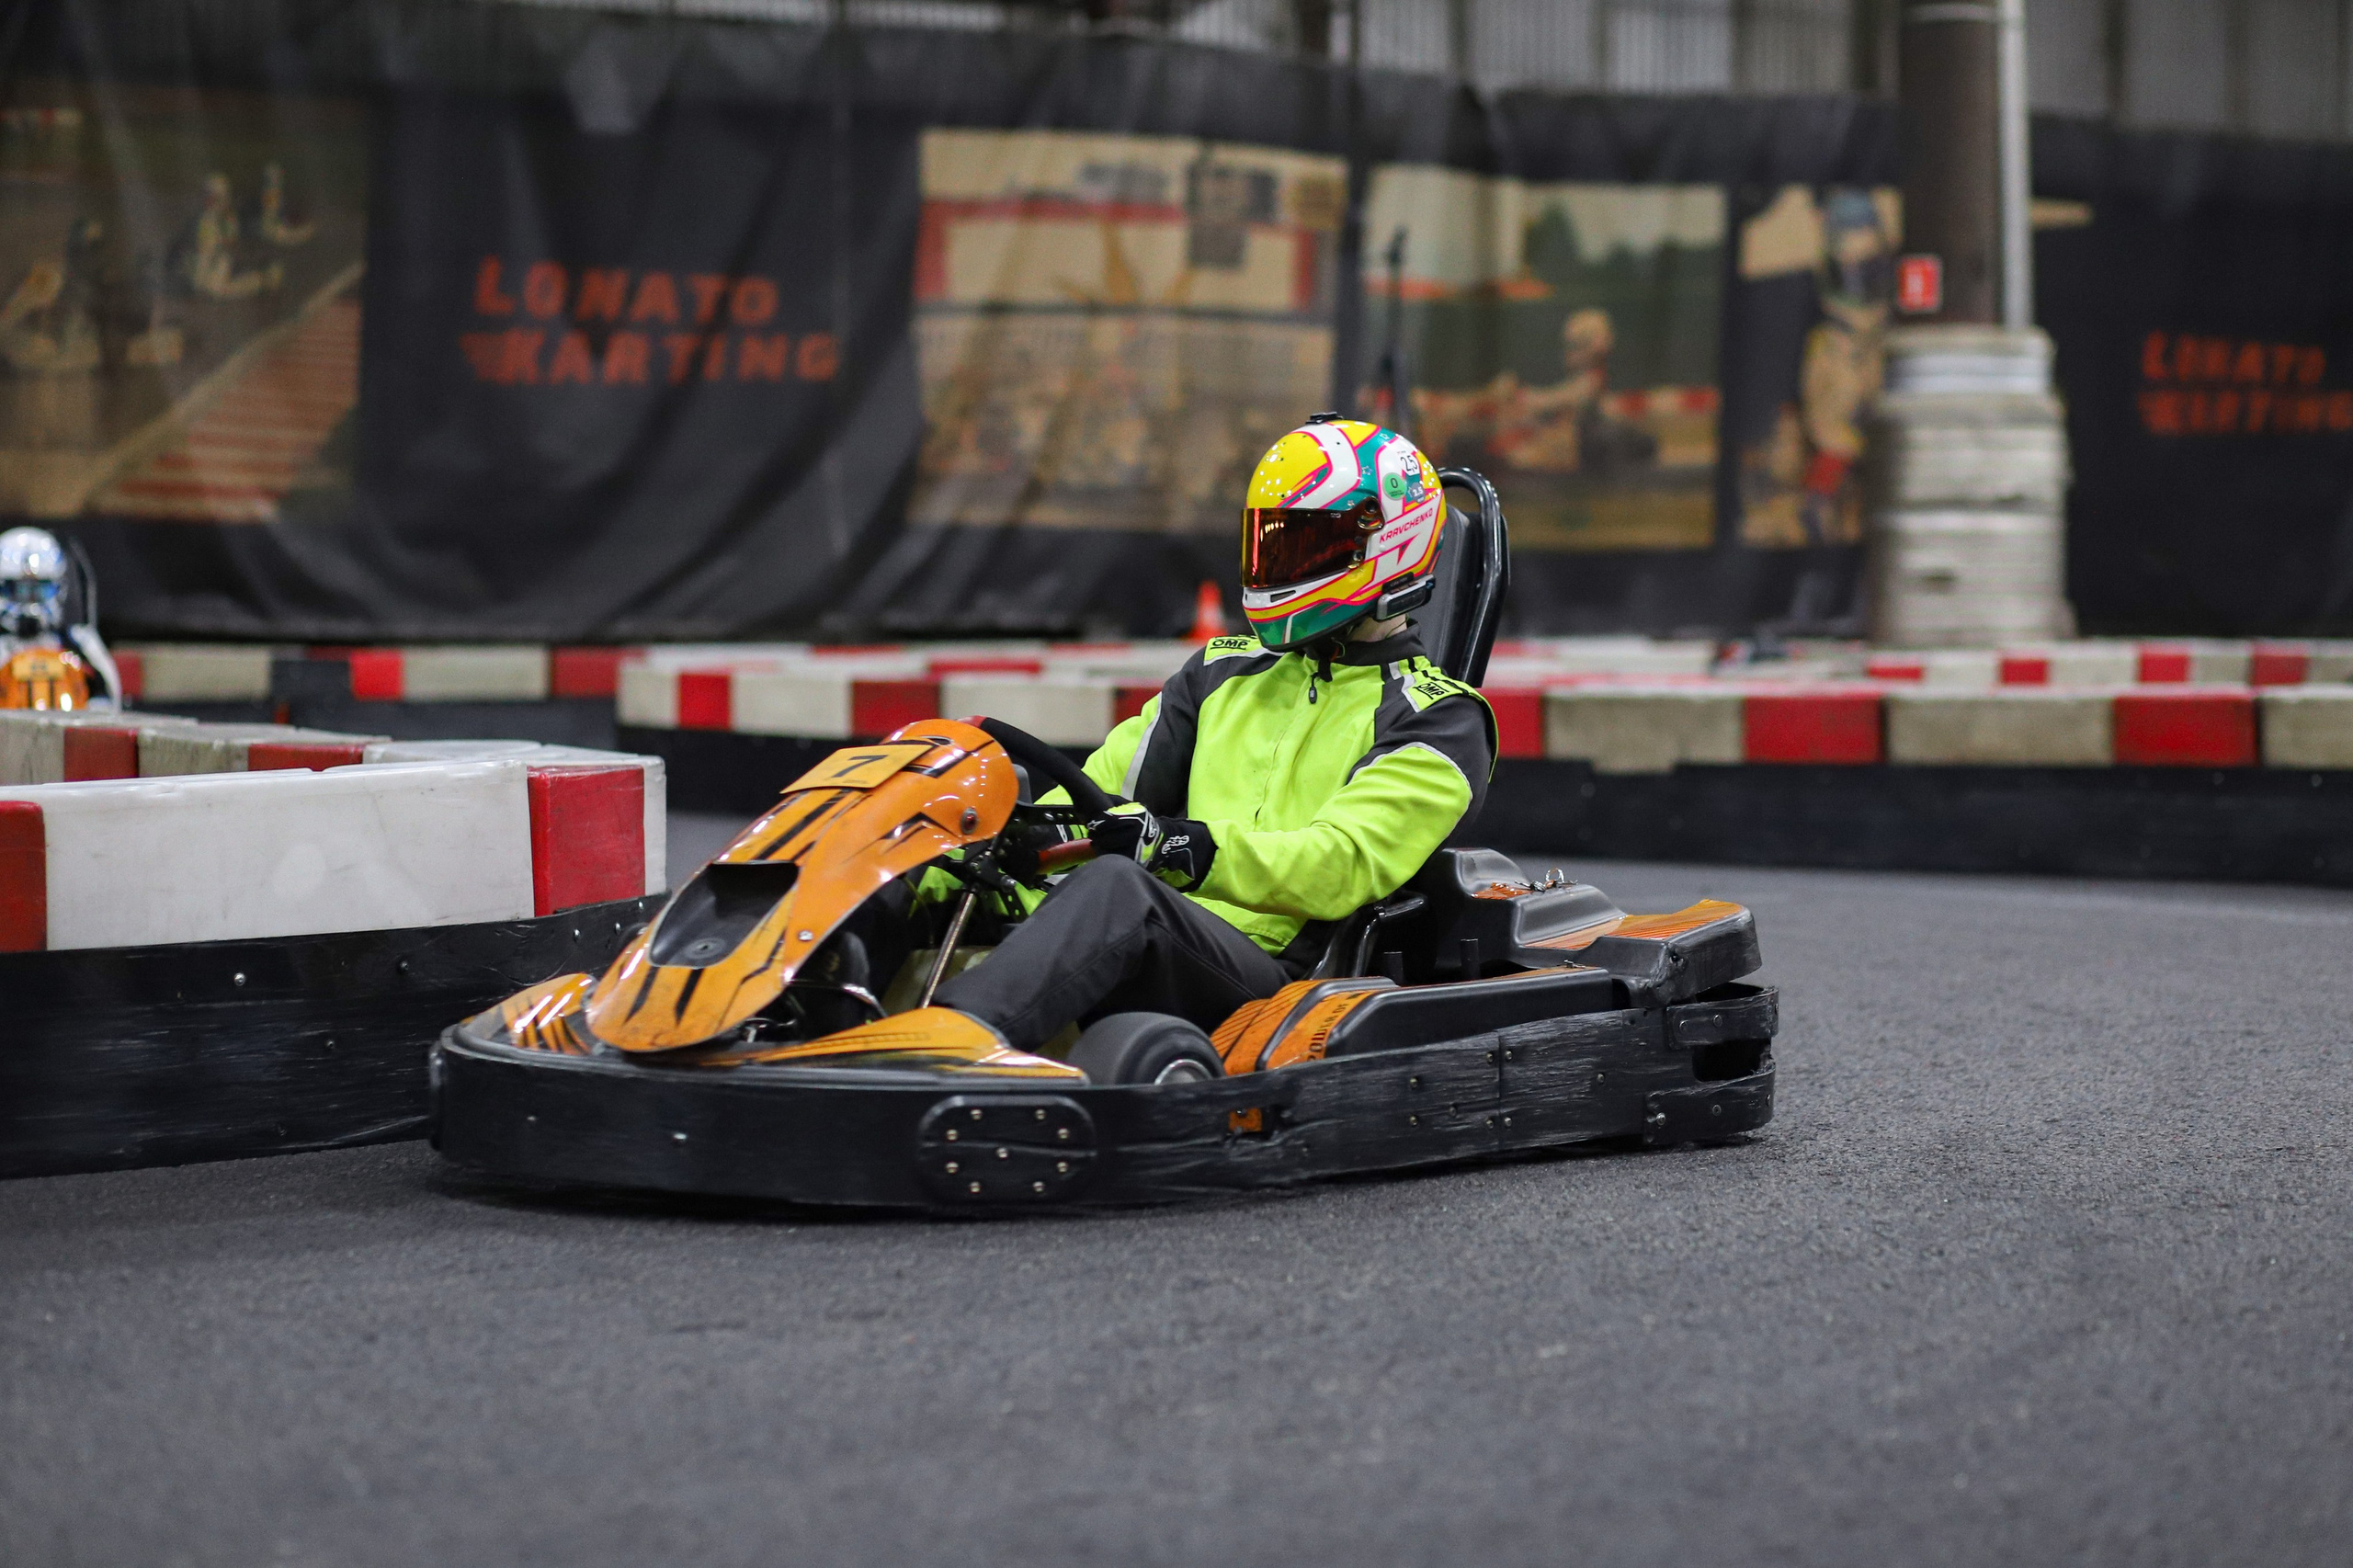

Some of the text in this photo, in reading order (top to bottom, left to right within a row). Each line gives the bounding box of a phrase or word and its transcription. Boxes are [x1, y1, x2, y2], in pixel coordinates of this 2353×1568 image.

[474, 254, 779, 325] LONATO
[462, 328, 840, 386] KARTING
[1379, 507, 1433, 543] KRAVCHENKO
[1211, 639, 1249, 648] OMP
[1416, 683, 1446, 697] OMP
[831, 754, 889, 778] 7
